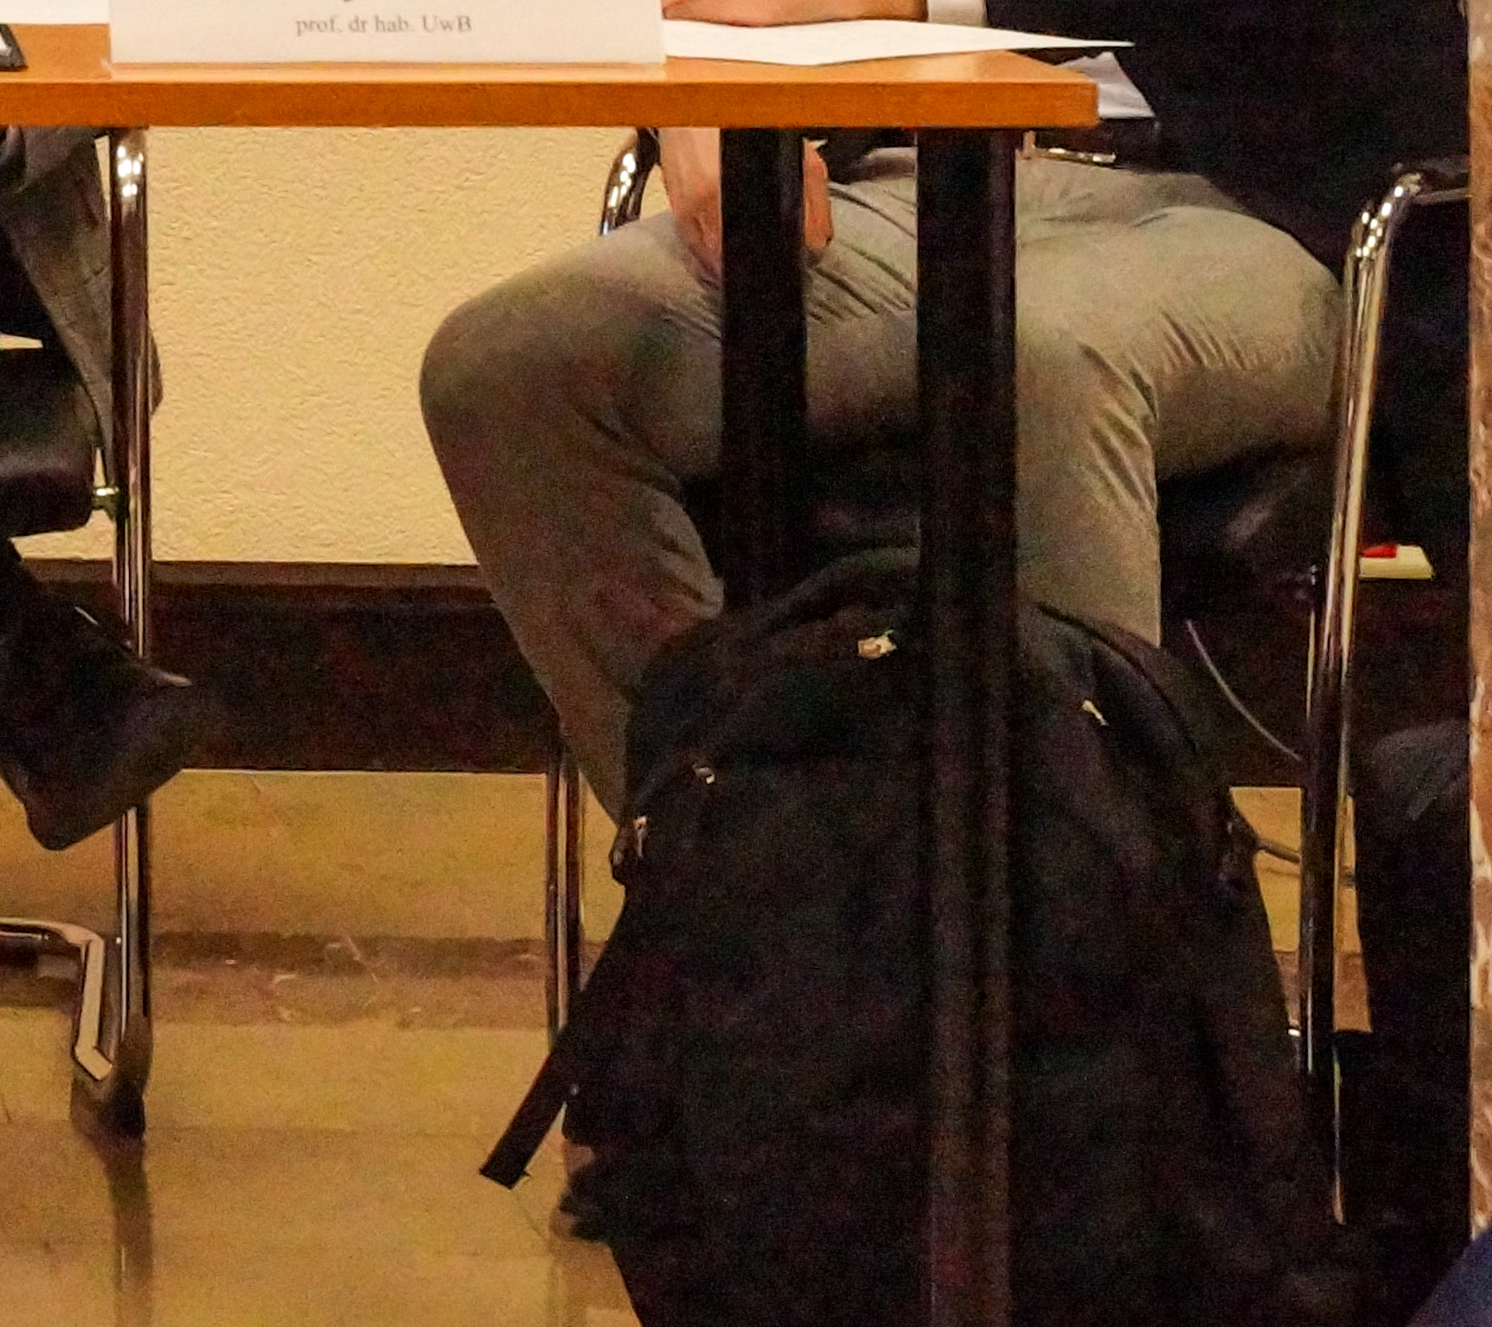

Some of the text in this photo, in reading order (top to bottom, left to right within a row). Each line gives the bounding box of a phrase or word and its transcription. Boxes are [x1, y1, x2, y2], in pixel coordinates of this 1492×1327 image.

[295, 15, 343, 37] prof.
[348, 16, 368, 33] dr
[421, 15, 473, 34] UwB
